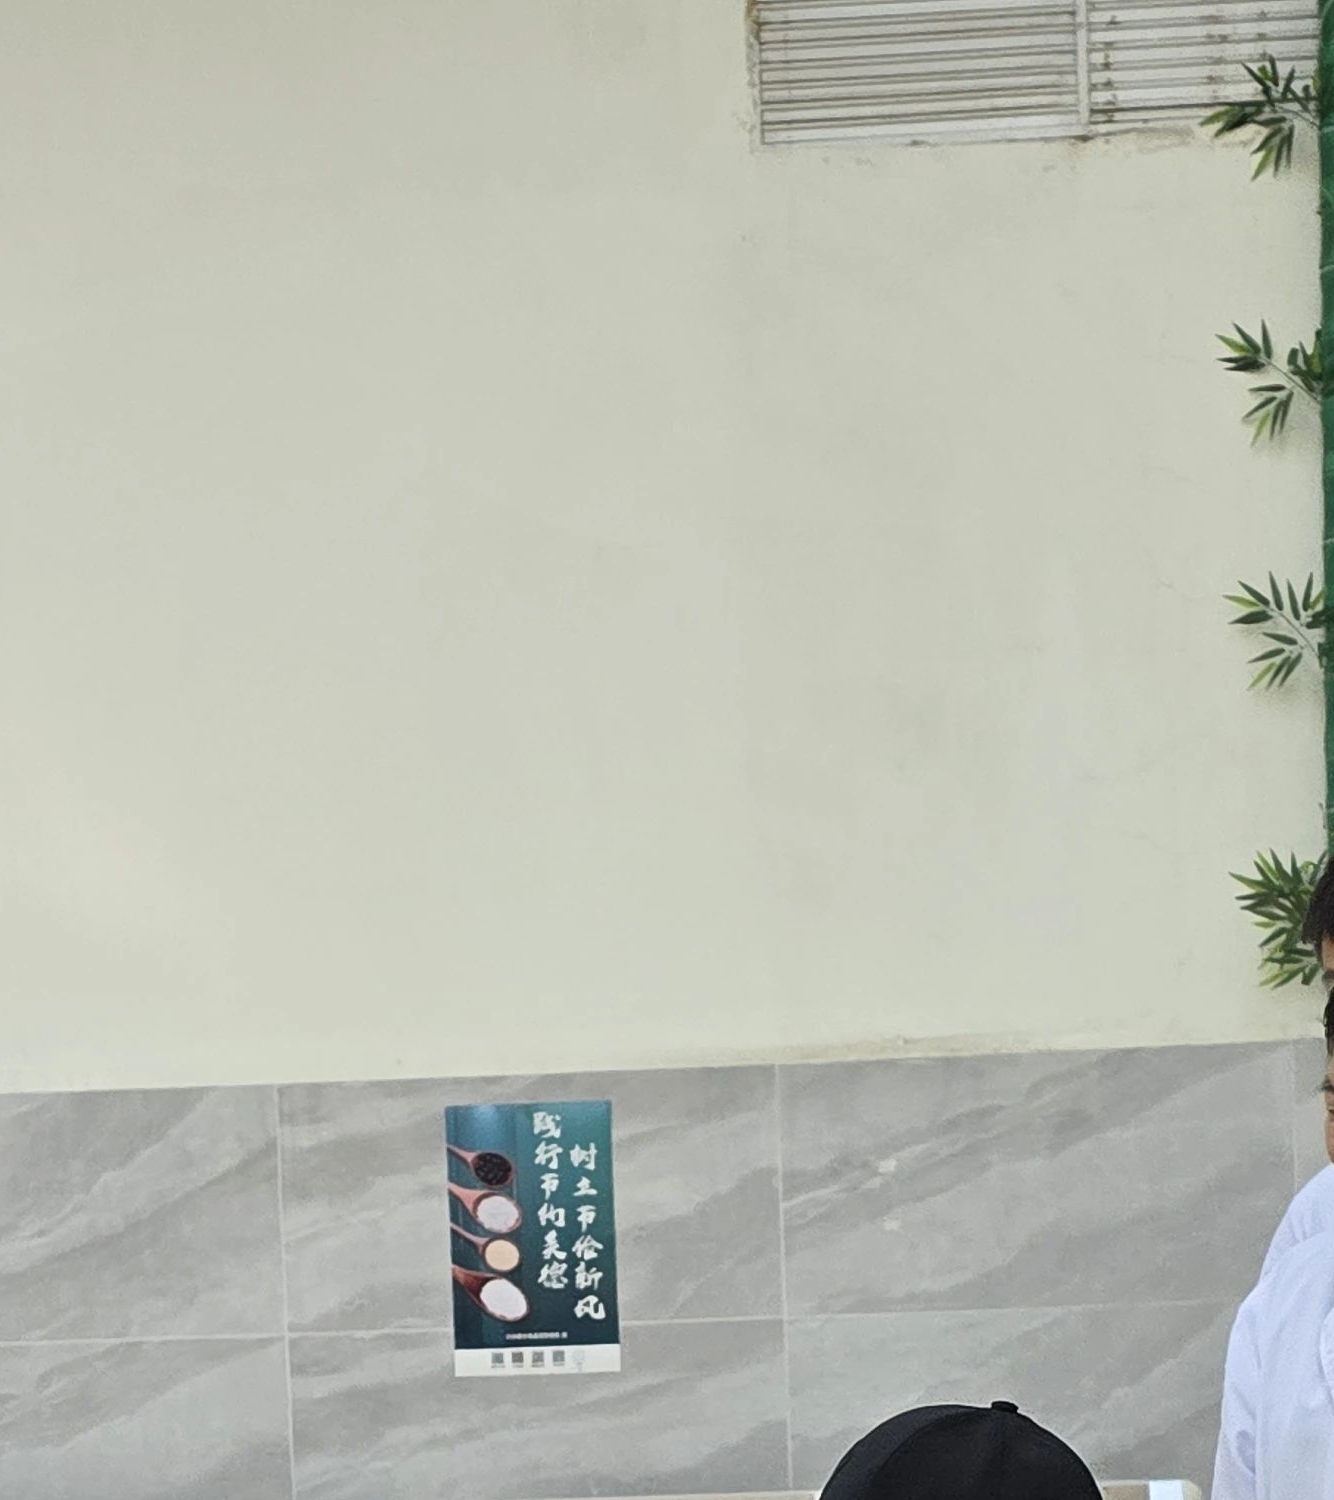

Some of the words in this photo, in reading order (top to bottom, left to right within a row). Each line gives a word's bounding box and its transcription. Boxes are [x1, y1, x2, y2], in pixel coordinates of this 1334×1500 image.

[533, 1111, 569, 1289] 践行节约美德
[569, 1142, 606, 1320] 树立节俭新风
